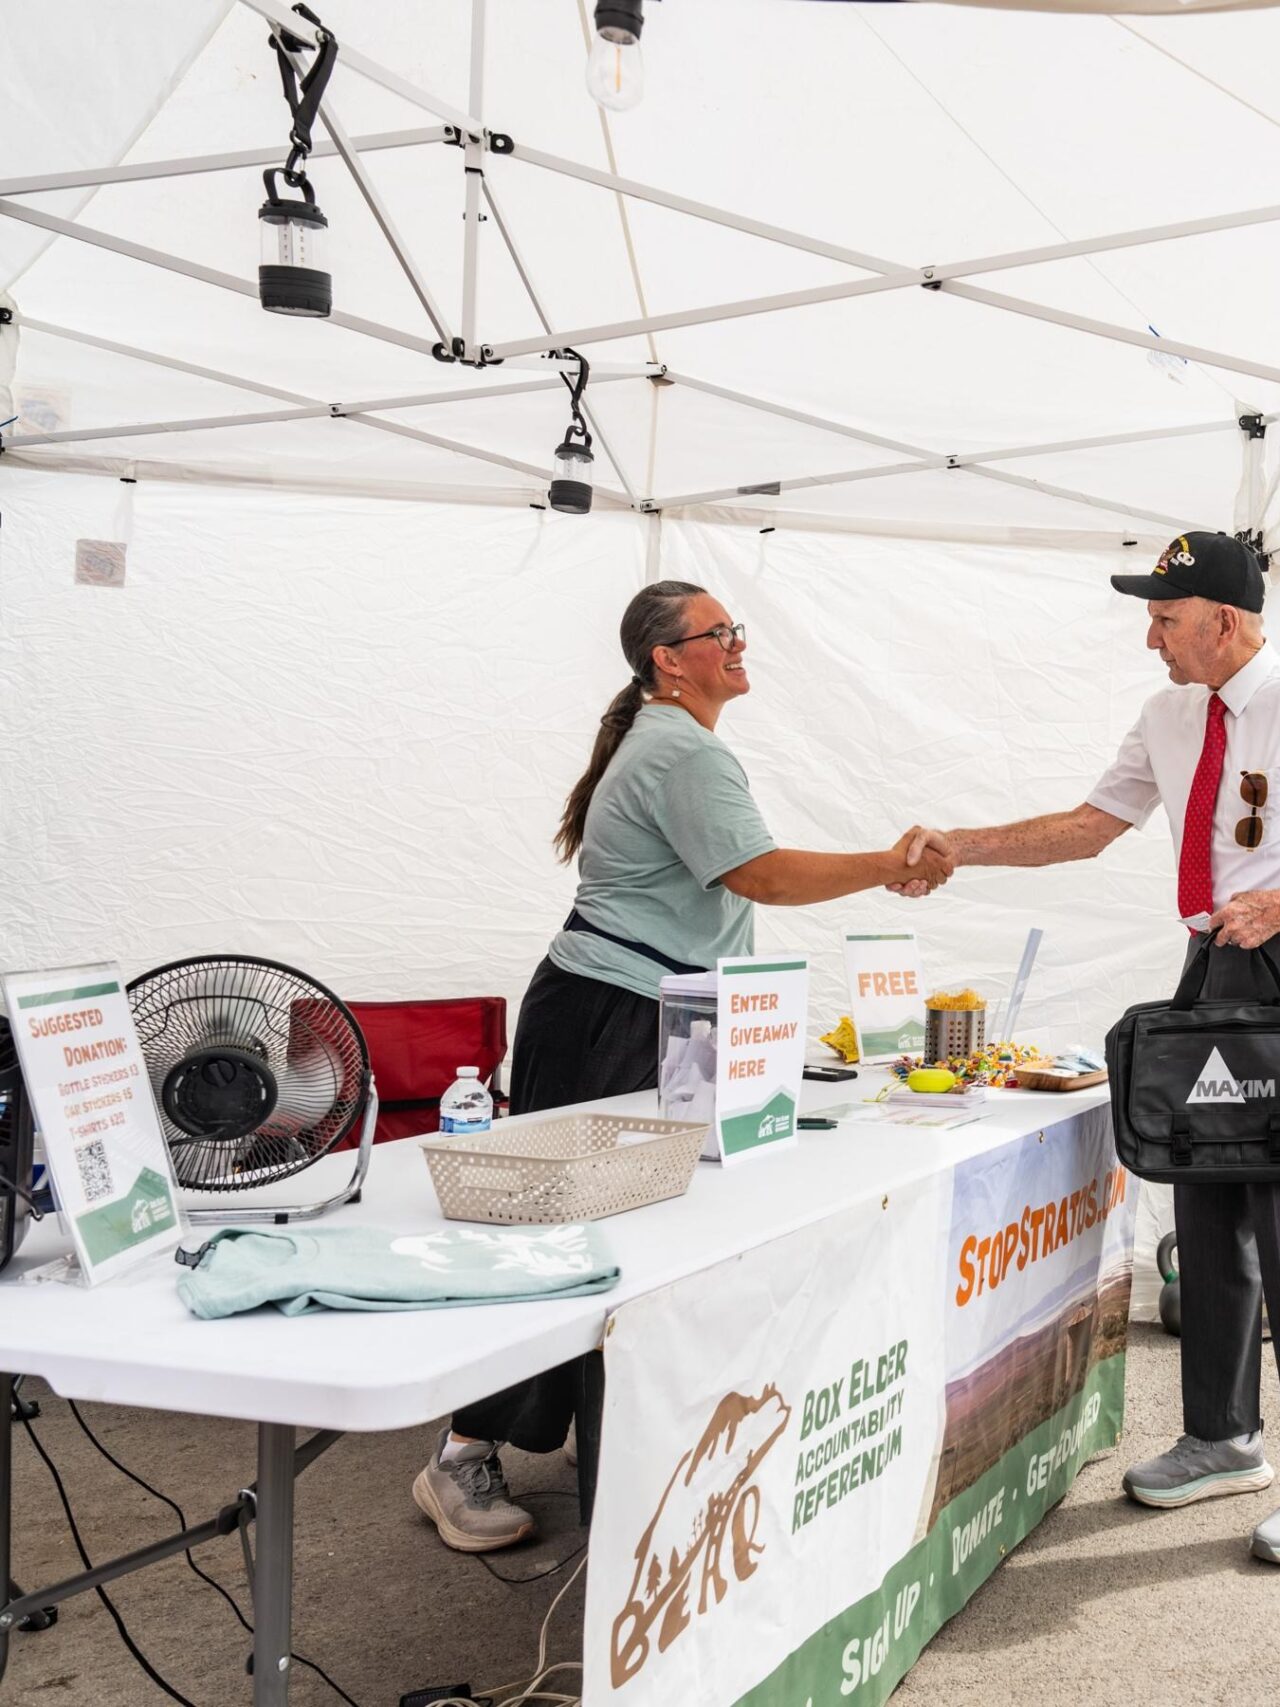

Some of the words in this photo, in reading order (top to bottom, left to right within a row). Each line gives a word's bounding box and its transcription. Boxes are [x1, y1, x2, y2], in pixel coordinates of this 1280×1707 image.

[858, 970, 918, 998] FREE
[730, 993, 779, 1014] ENTER
[28, 1008, 104, 1038] SUGGESTED
[730, 1022, 798, 1047] GIVEAWAY
[63, 1037, 128, 1067] DONATION:
[728, 1058, 766, 1080] HERE
[1196, 1079, 1276, 1098] MAXIM
[955, 1165, 1127, 1308] STOPSTRATOS.CM
[799, 1377, 845, 1442] BOX
[848, 1339, 908, 1408] ELDER
[794, 1388, 904, 1486] ACCOUNTABIITY
[1027, 1445, 1057, 1497] GET
[1054, 1391, 1101, 1471] EDUED
[951, 1486, 1005, 1576] DONATE
[840, 1610, 890, 1696] SIGN
[894, 1581, 920, 1640] UP
